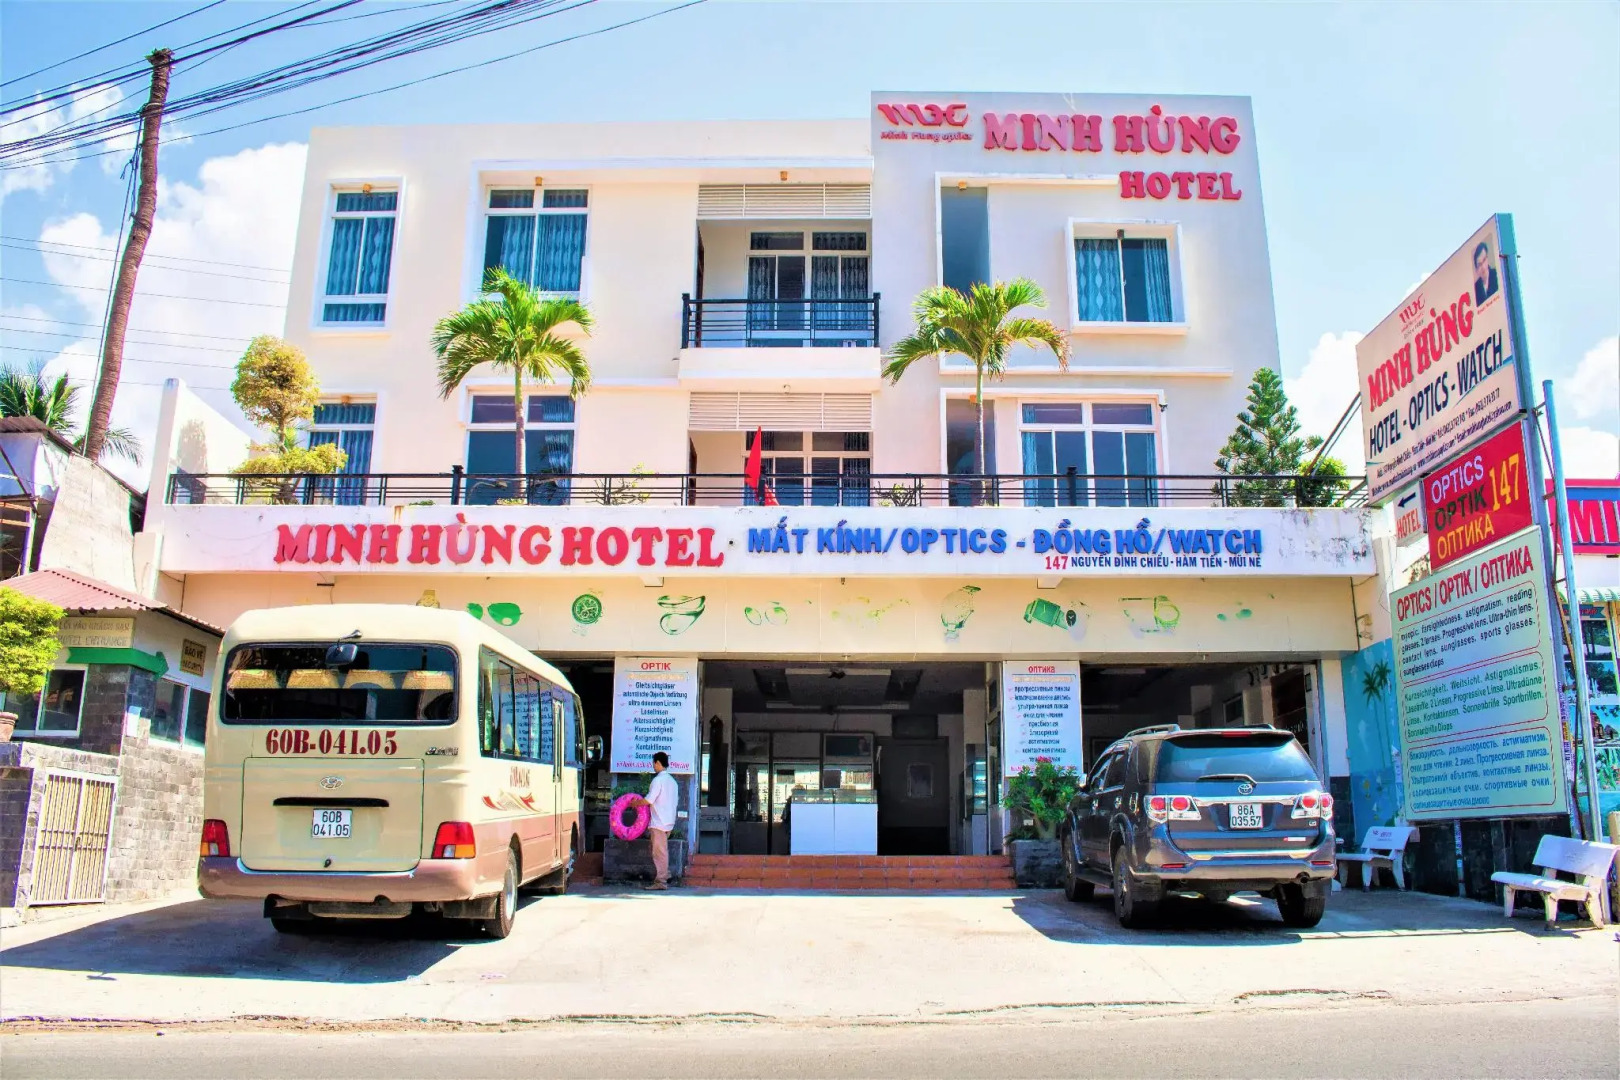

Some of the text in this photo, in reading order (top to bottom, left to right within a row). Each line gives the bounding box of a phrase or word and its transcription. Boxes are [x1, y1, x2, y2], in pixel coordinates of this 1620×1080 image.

[983, 112, 1103, 152] MINH
[1119, 171, 1242, 200] HOTEL
[1368, 342, 1413, 413] MINH
[1369, 409, 1401, 459] HOTEL
[1409, 371, 1449, 431] OPTICS
[1456, 329, 1503, 397] WATCH
[1431, 455, 1484, 504] OPTICS
[1489, 453, 1520, 512] 147
[1434, 485, 1487, 531] OPTIK
[748, 516, 809, 554] MẮT
[817, 519, 1008, 554] KÍNH/OPTICS
[1033, 518, 1111, 555] ĐỒNG
[1396, 507, 1421, 540] HOTEL
[1437, 513, 1495, 560] ОПТИКА
[273, 523, 401, 565] MINH
[560, 525, 725, 567] HOTEL
[1045, 555, 1068, 570] 147
[1114, 554, 1138, 567] ĐÌNH
[1176, 554, 1197, 567] HÀM
[1397, 586, 1432, 621] OPTICS
[1439, 569, 1473, 605] OPTIK
[1481, 545, 1534, 589] ОПТИКА
[1507, 588, 1533, 603] reading
[1480, 627, 1501, 642] sports
[640, 662, 671, 671] OPTIK
[265, 728, 398, 756] 60B-041.05
[1484, 779, 1528, 791] спортивные
[321, 810, 343, 824] 60B
[1231, 815, 1262, 828] 035.57
[1237, 804, 1255, 816] 86A
[313, 823, 350, 837] 041.05
